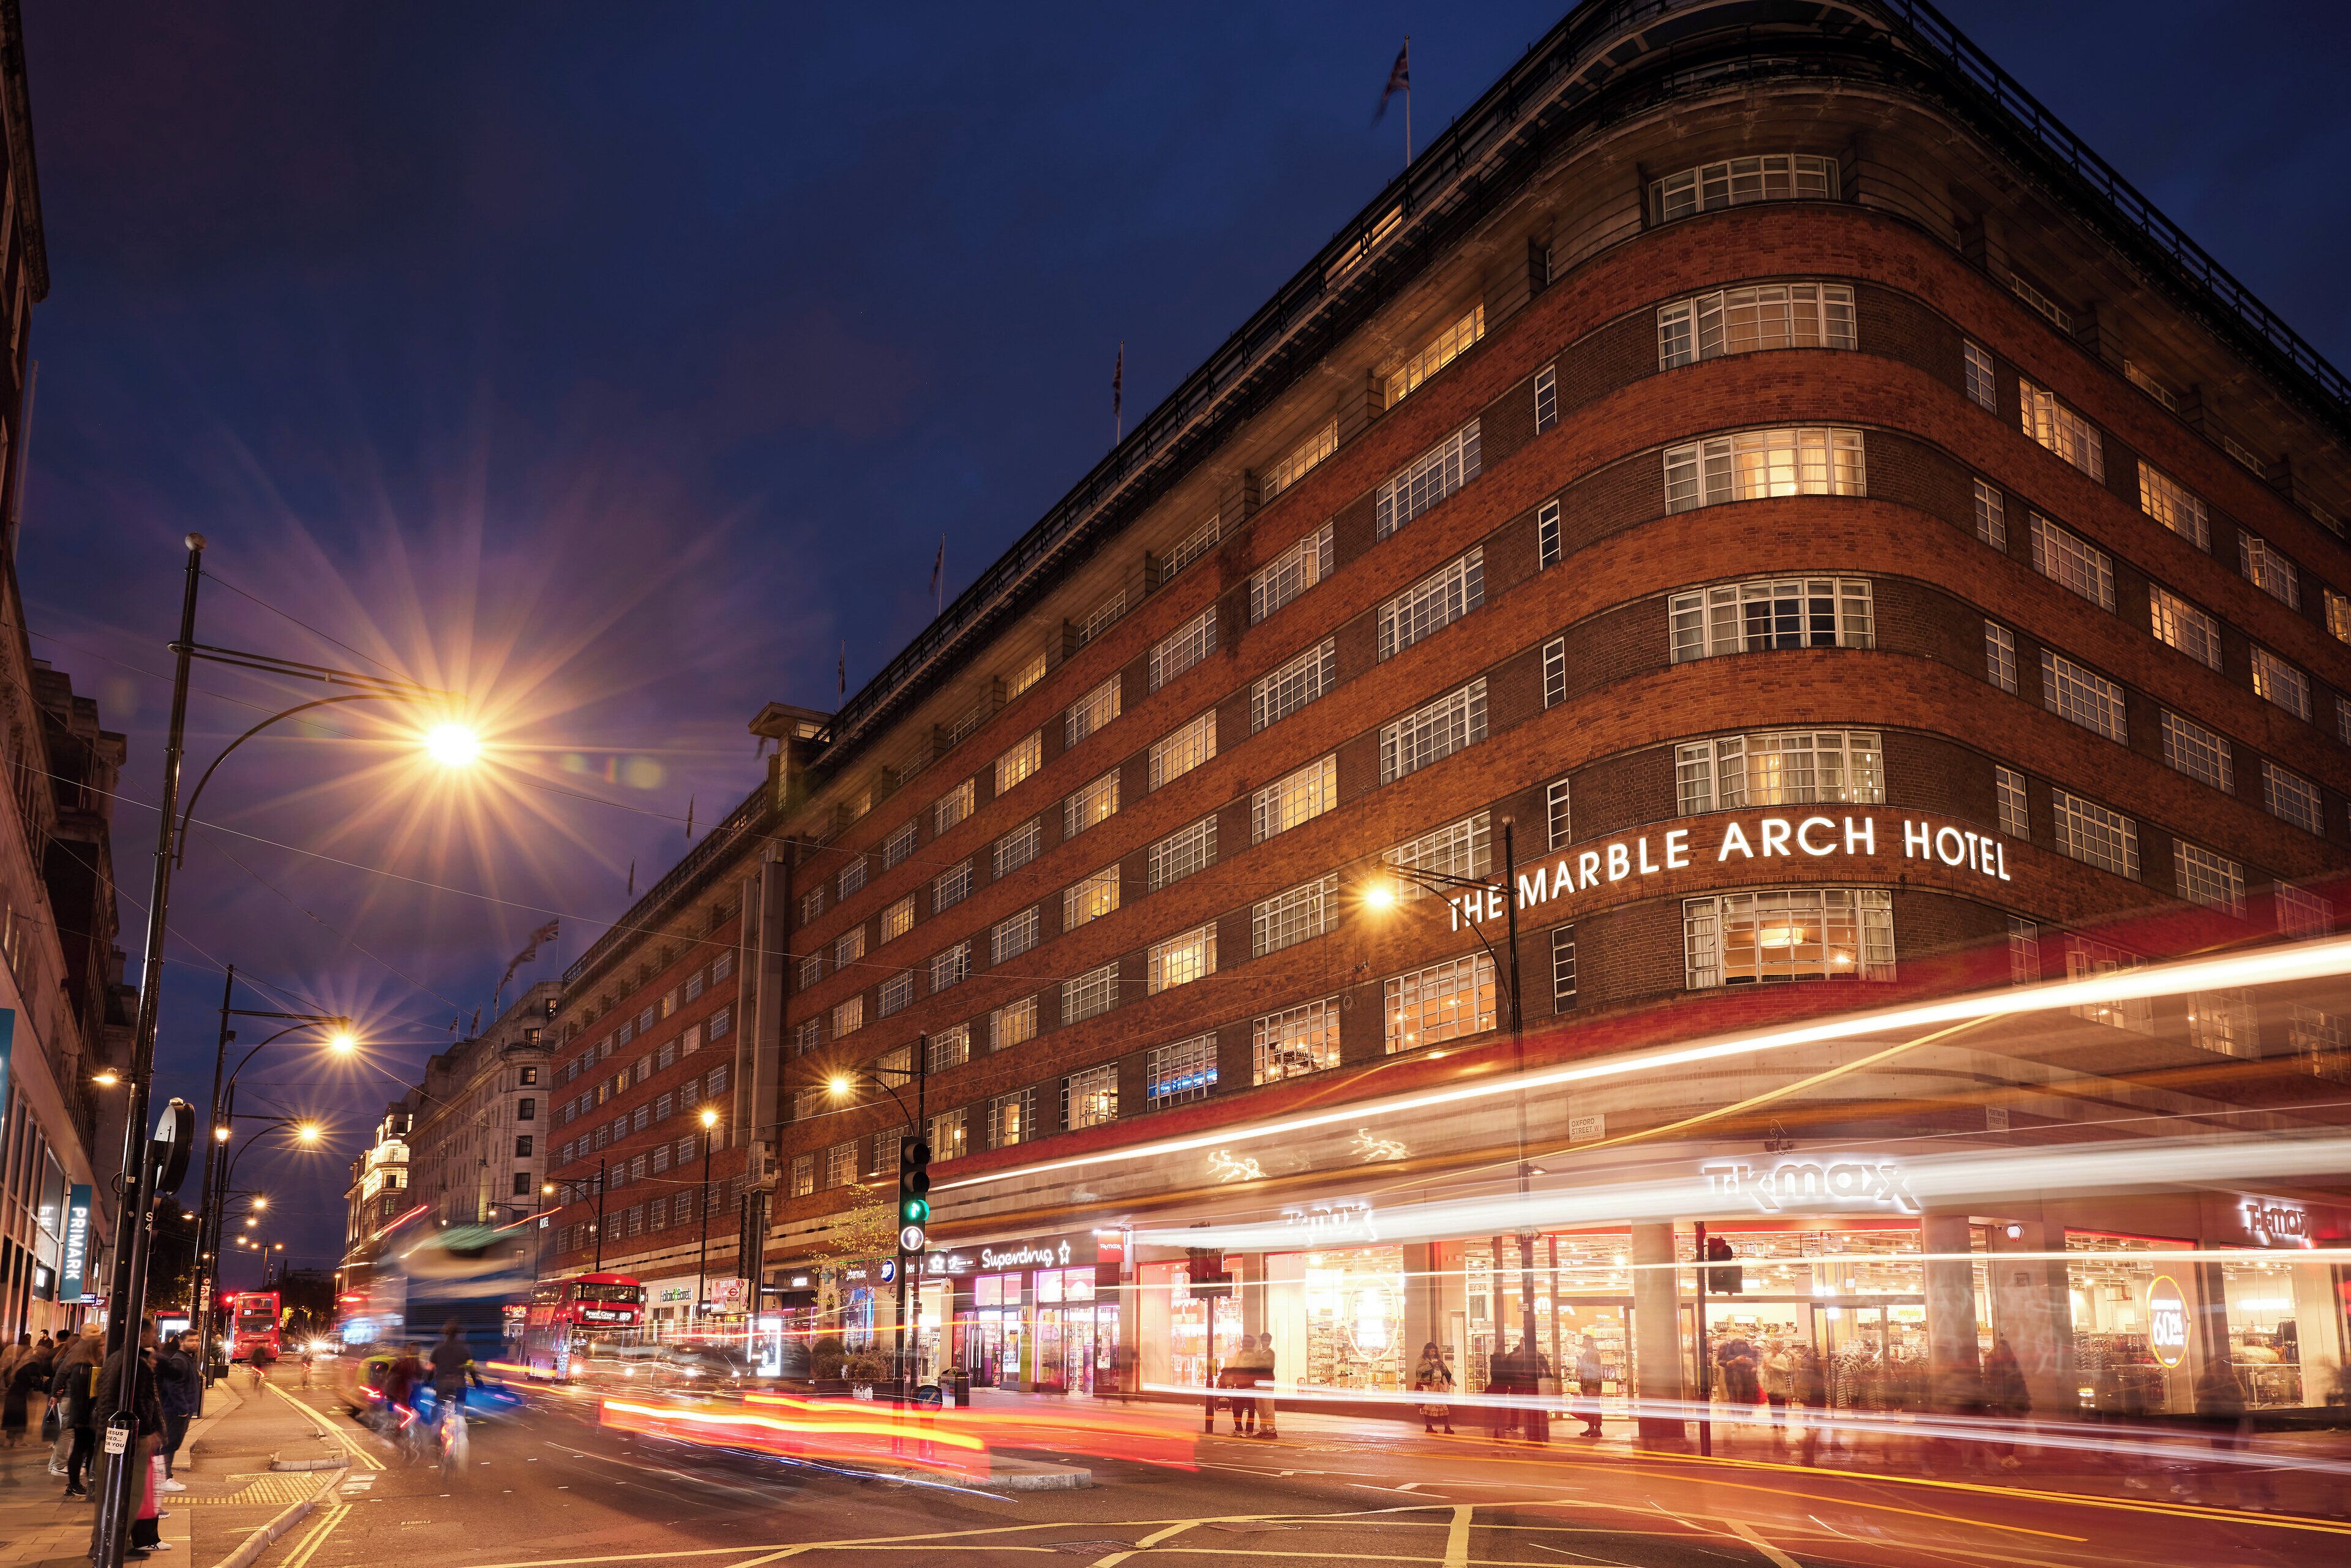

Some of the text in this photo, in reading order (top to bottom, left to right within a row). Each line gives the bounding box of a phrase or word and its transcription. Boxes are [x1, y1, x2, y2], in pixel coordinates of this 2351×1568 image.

[1449, 816, 2012, 932] THE MARBLE ARCH HOTEL
[1989, 1109, 2005, 1118] PORTMAN
[1572, 1118, 1595, 1127] OXFORD
[1572, 1126, 1592, 1135] STREET
[145, 1212, 153, 1221] S
[144, 1223, 152, 1232] 4
[65, 1207, 87, 1280] PRIMARK
[982, 1246, 1054, 1271] Superdrug
[619, 1312, 631, 1321] 189
[1898, 1308, 1922, 1320] everyday
